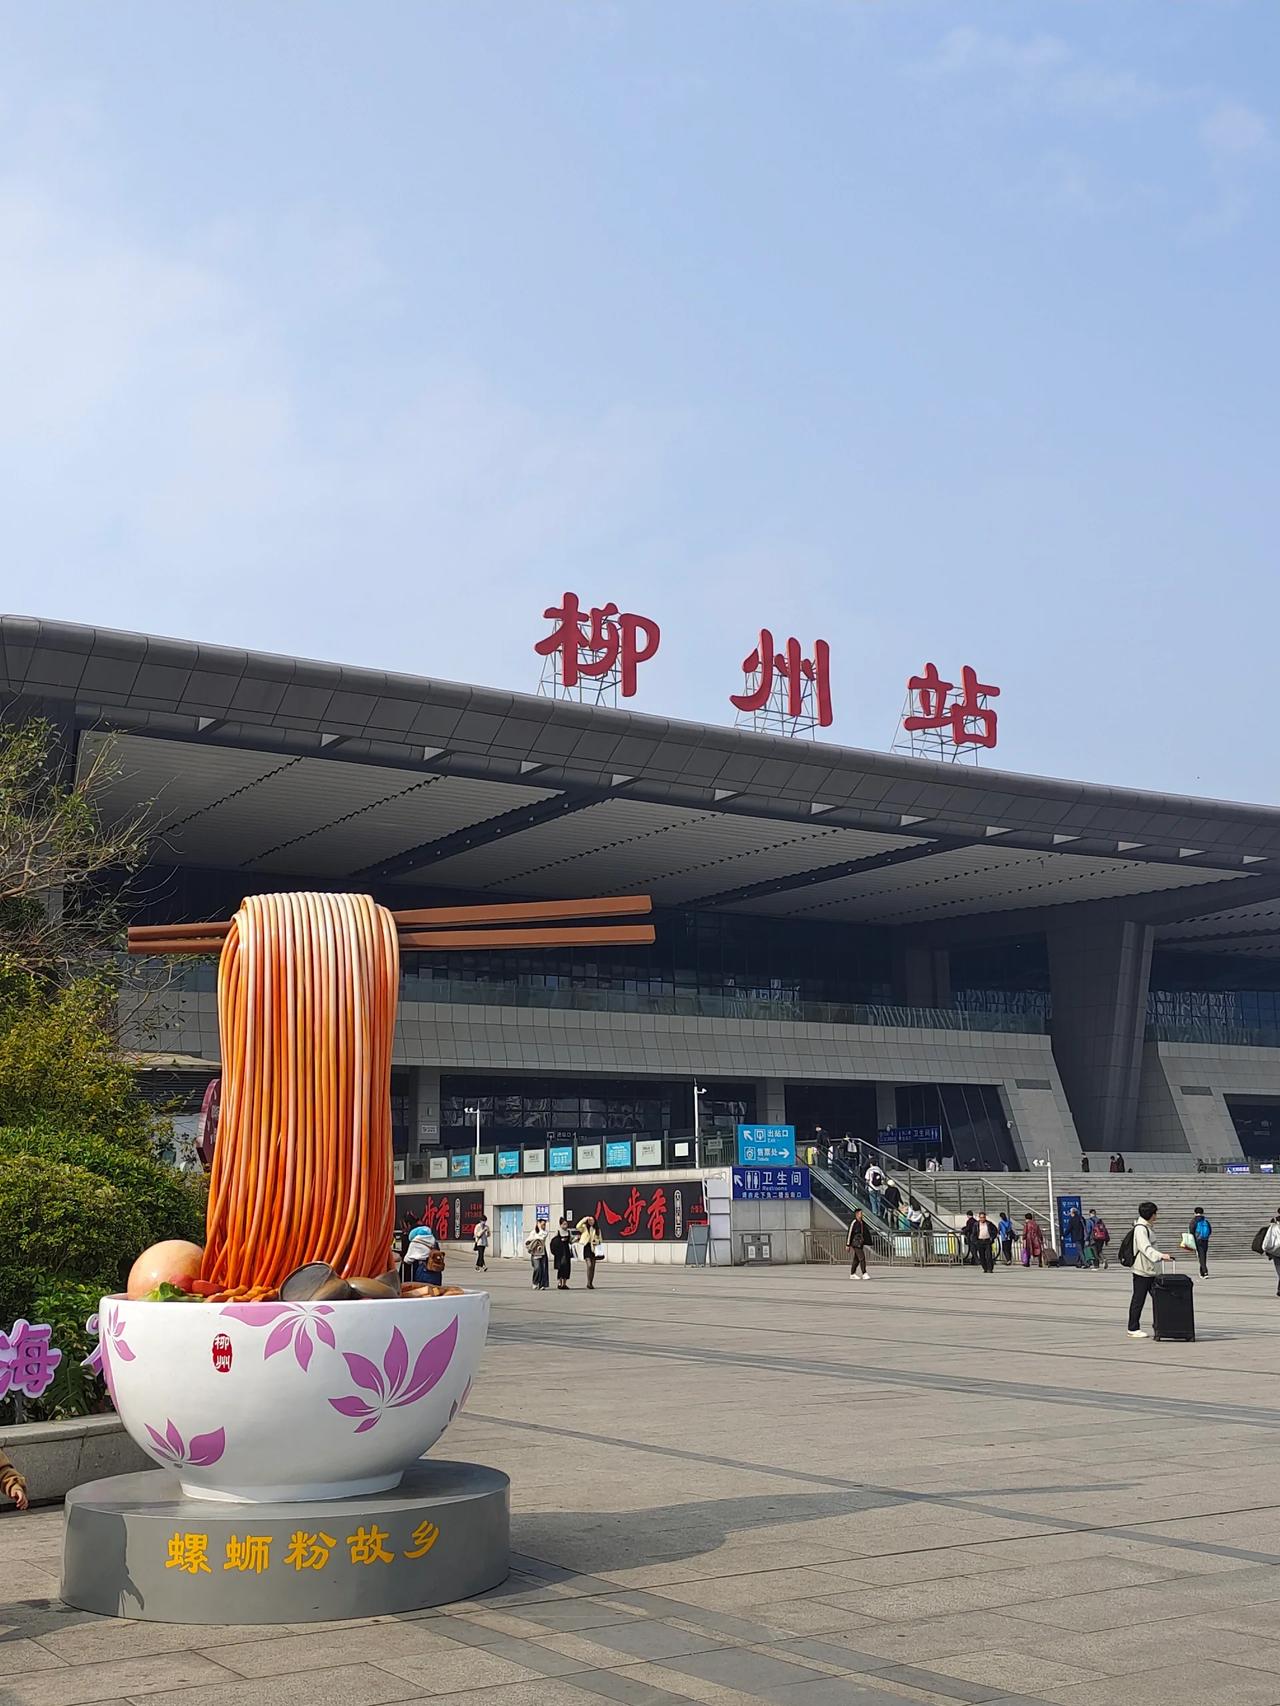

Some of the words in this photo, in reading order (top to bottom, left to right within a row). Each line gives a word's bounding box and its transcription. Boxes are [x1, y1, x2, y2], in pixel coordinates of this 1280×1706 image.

[535, 592, 1000, 748] 柳州站
[767, 1129, 789, 1138] 出站口
[757, 1147, 778, 1157] 售票处
[762, 1170, 802, 1186] 卫生间
[594, 1187, 668, 1240] 八步香
[214, 1335, 231, 1370] 柳州
[164, 1520, 440, 1576] 螺蛳粉故乡
